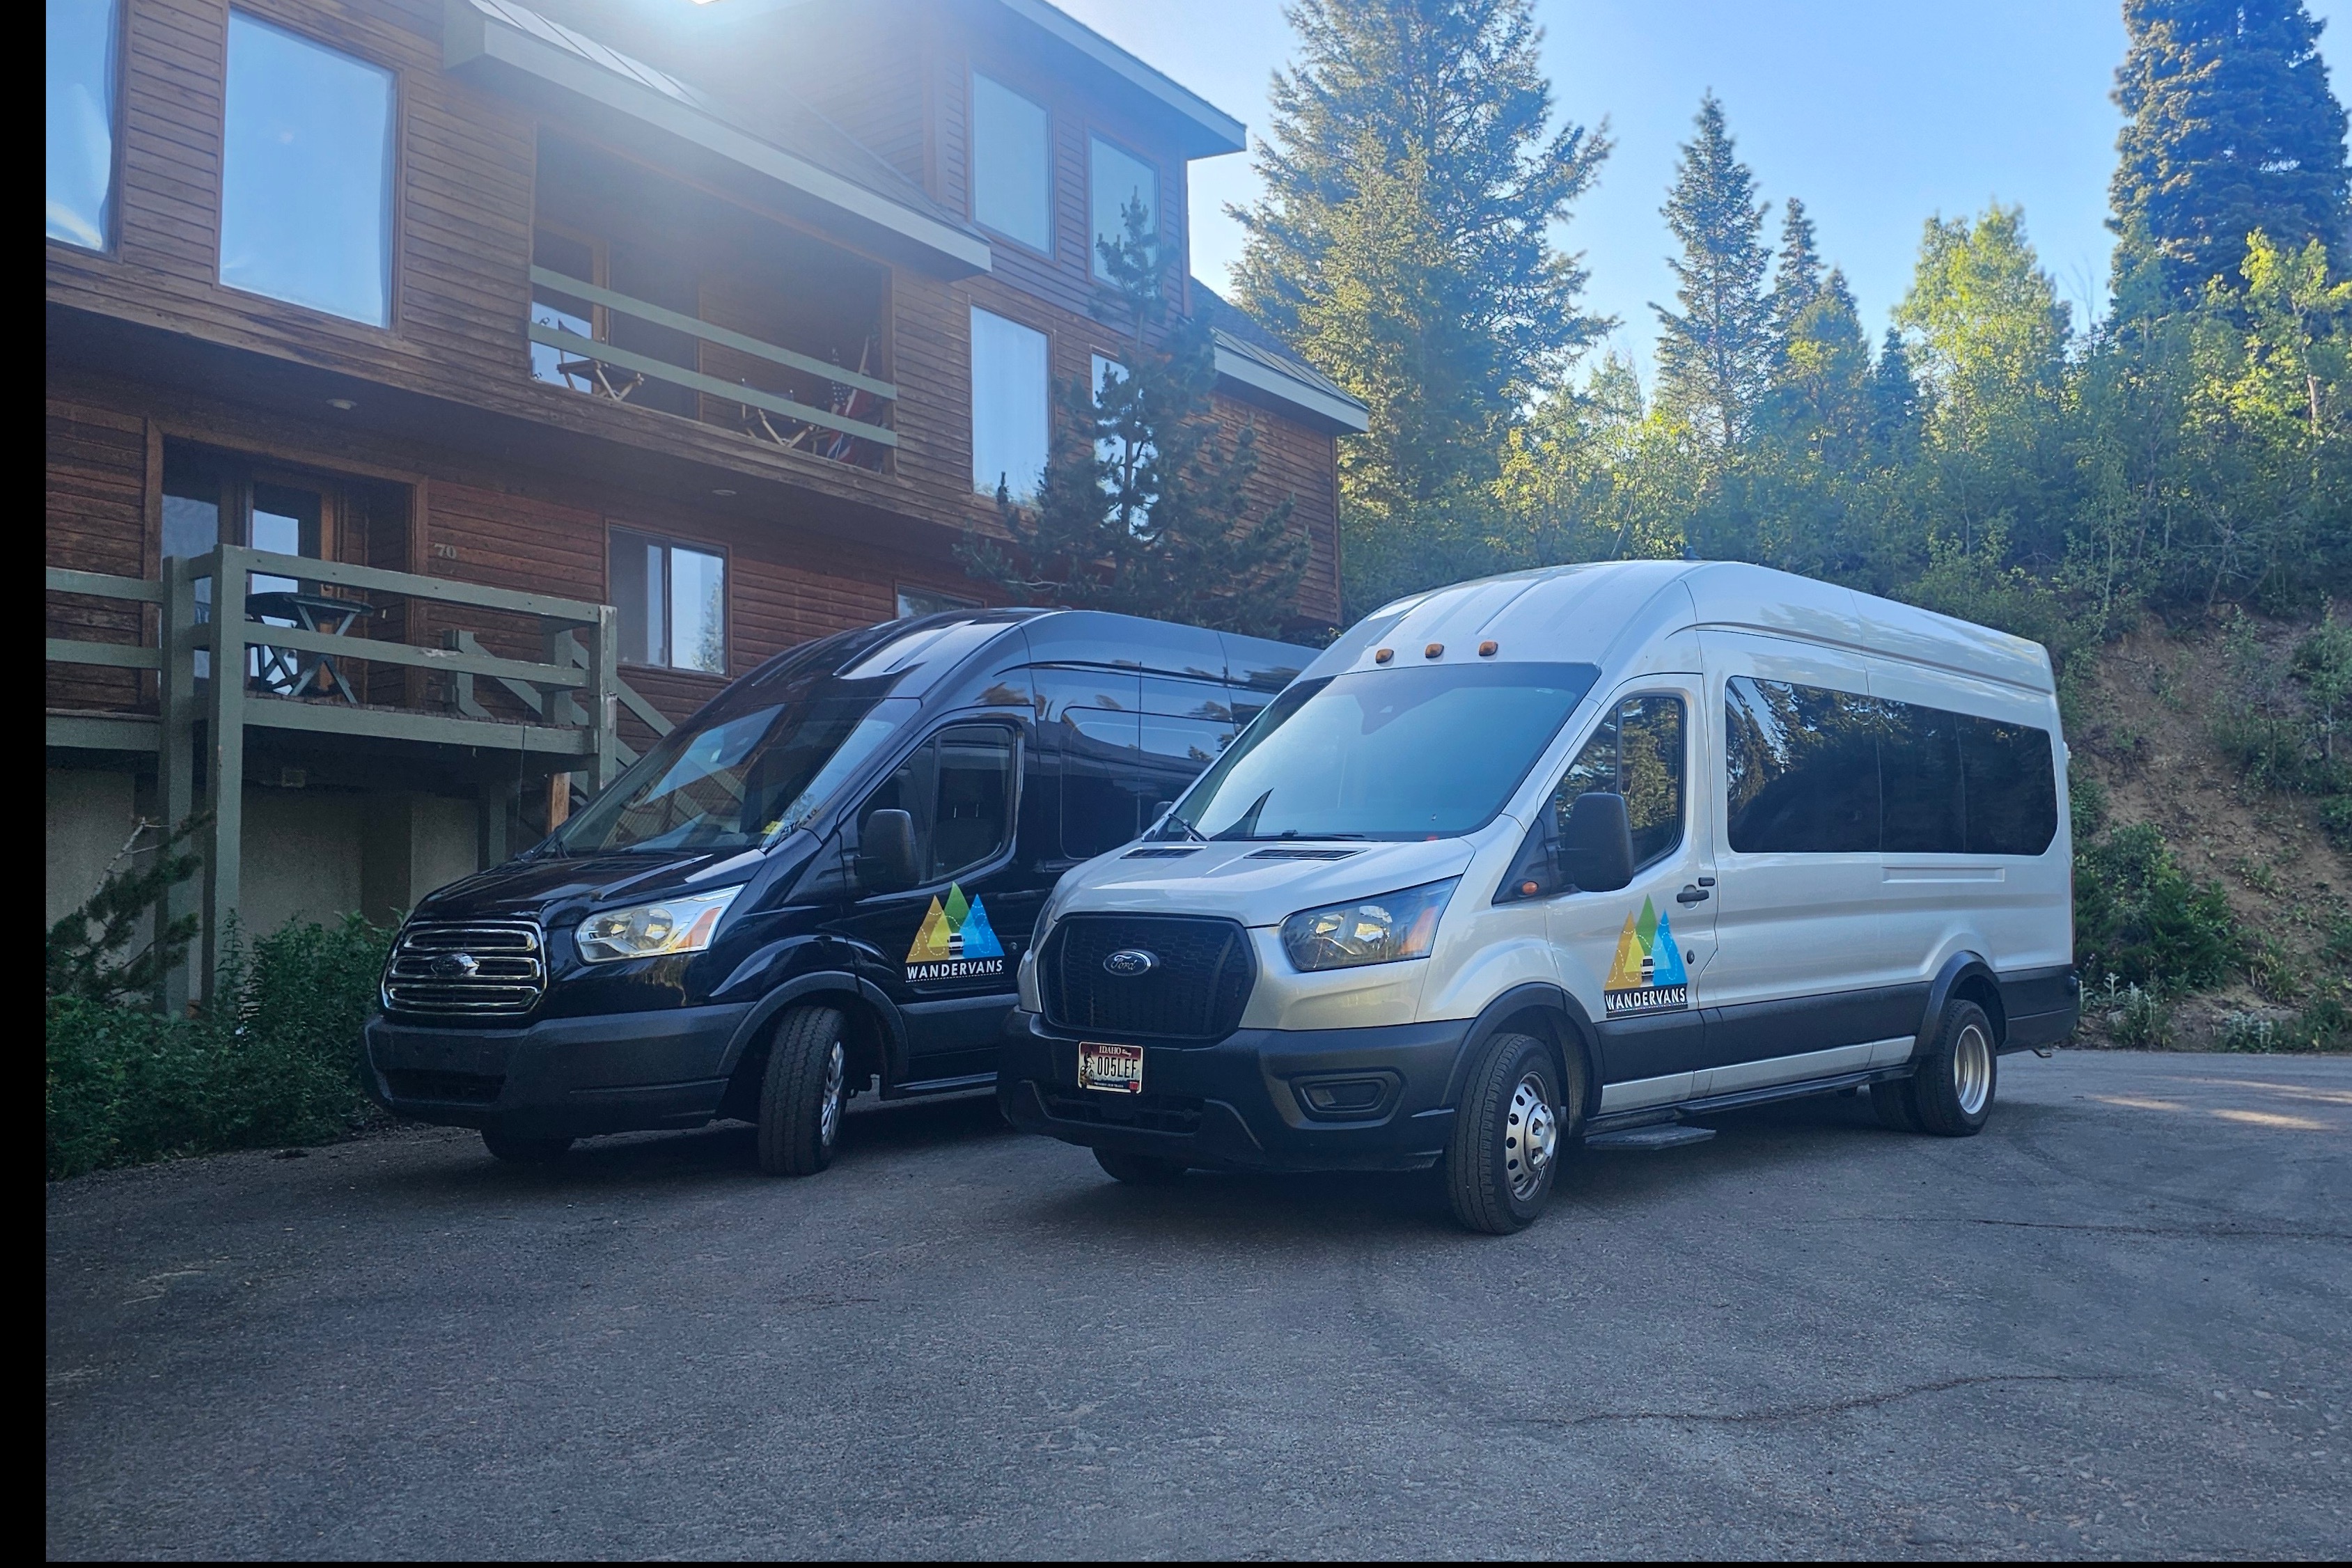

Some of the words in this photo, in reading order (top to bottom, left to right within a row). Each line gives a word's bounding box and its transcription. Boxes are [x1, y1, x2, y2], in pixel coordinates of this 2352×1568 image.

[434, 543, 457, 558] 70
[907, 959, 1003, 980] WANDERVANS
[1111, 955, 1138, 971] Ford
[1605, 987, 1686, 1010] WANDERVANS
[1099, 1045, 1122, 1055] IDAHO
[1097, 1056, 1138, 1079] 005LEF
